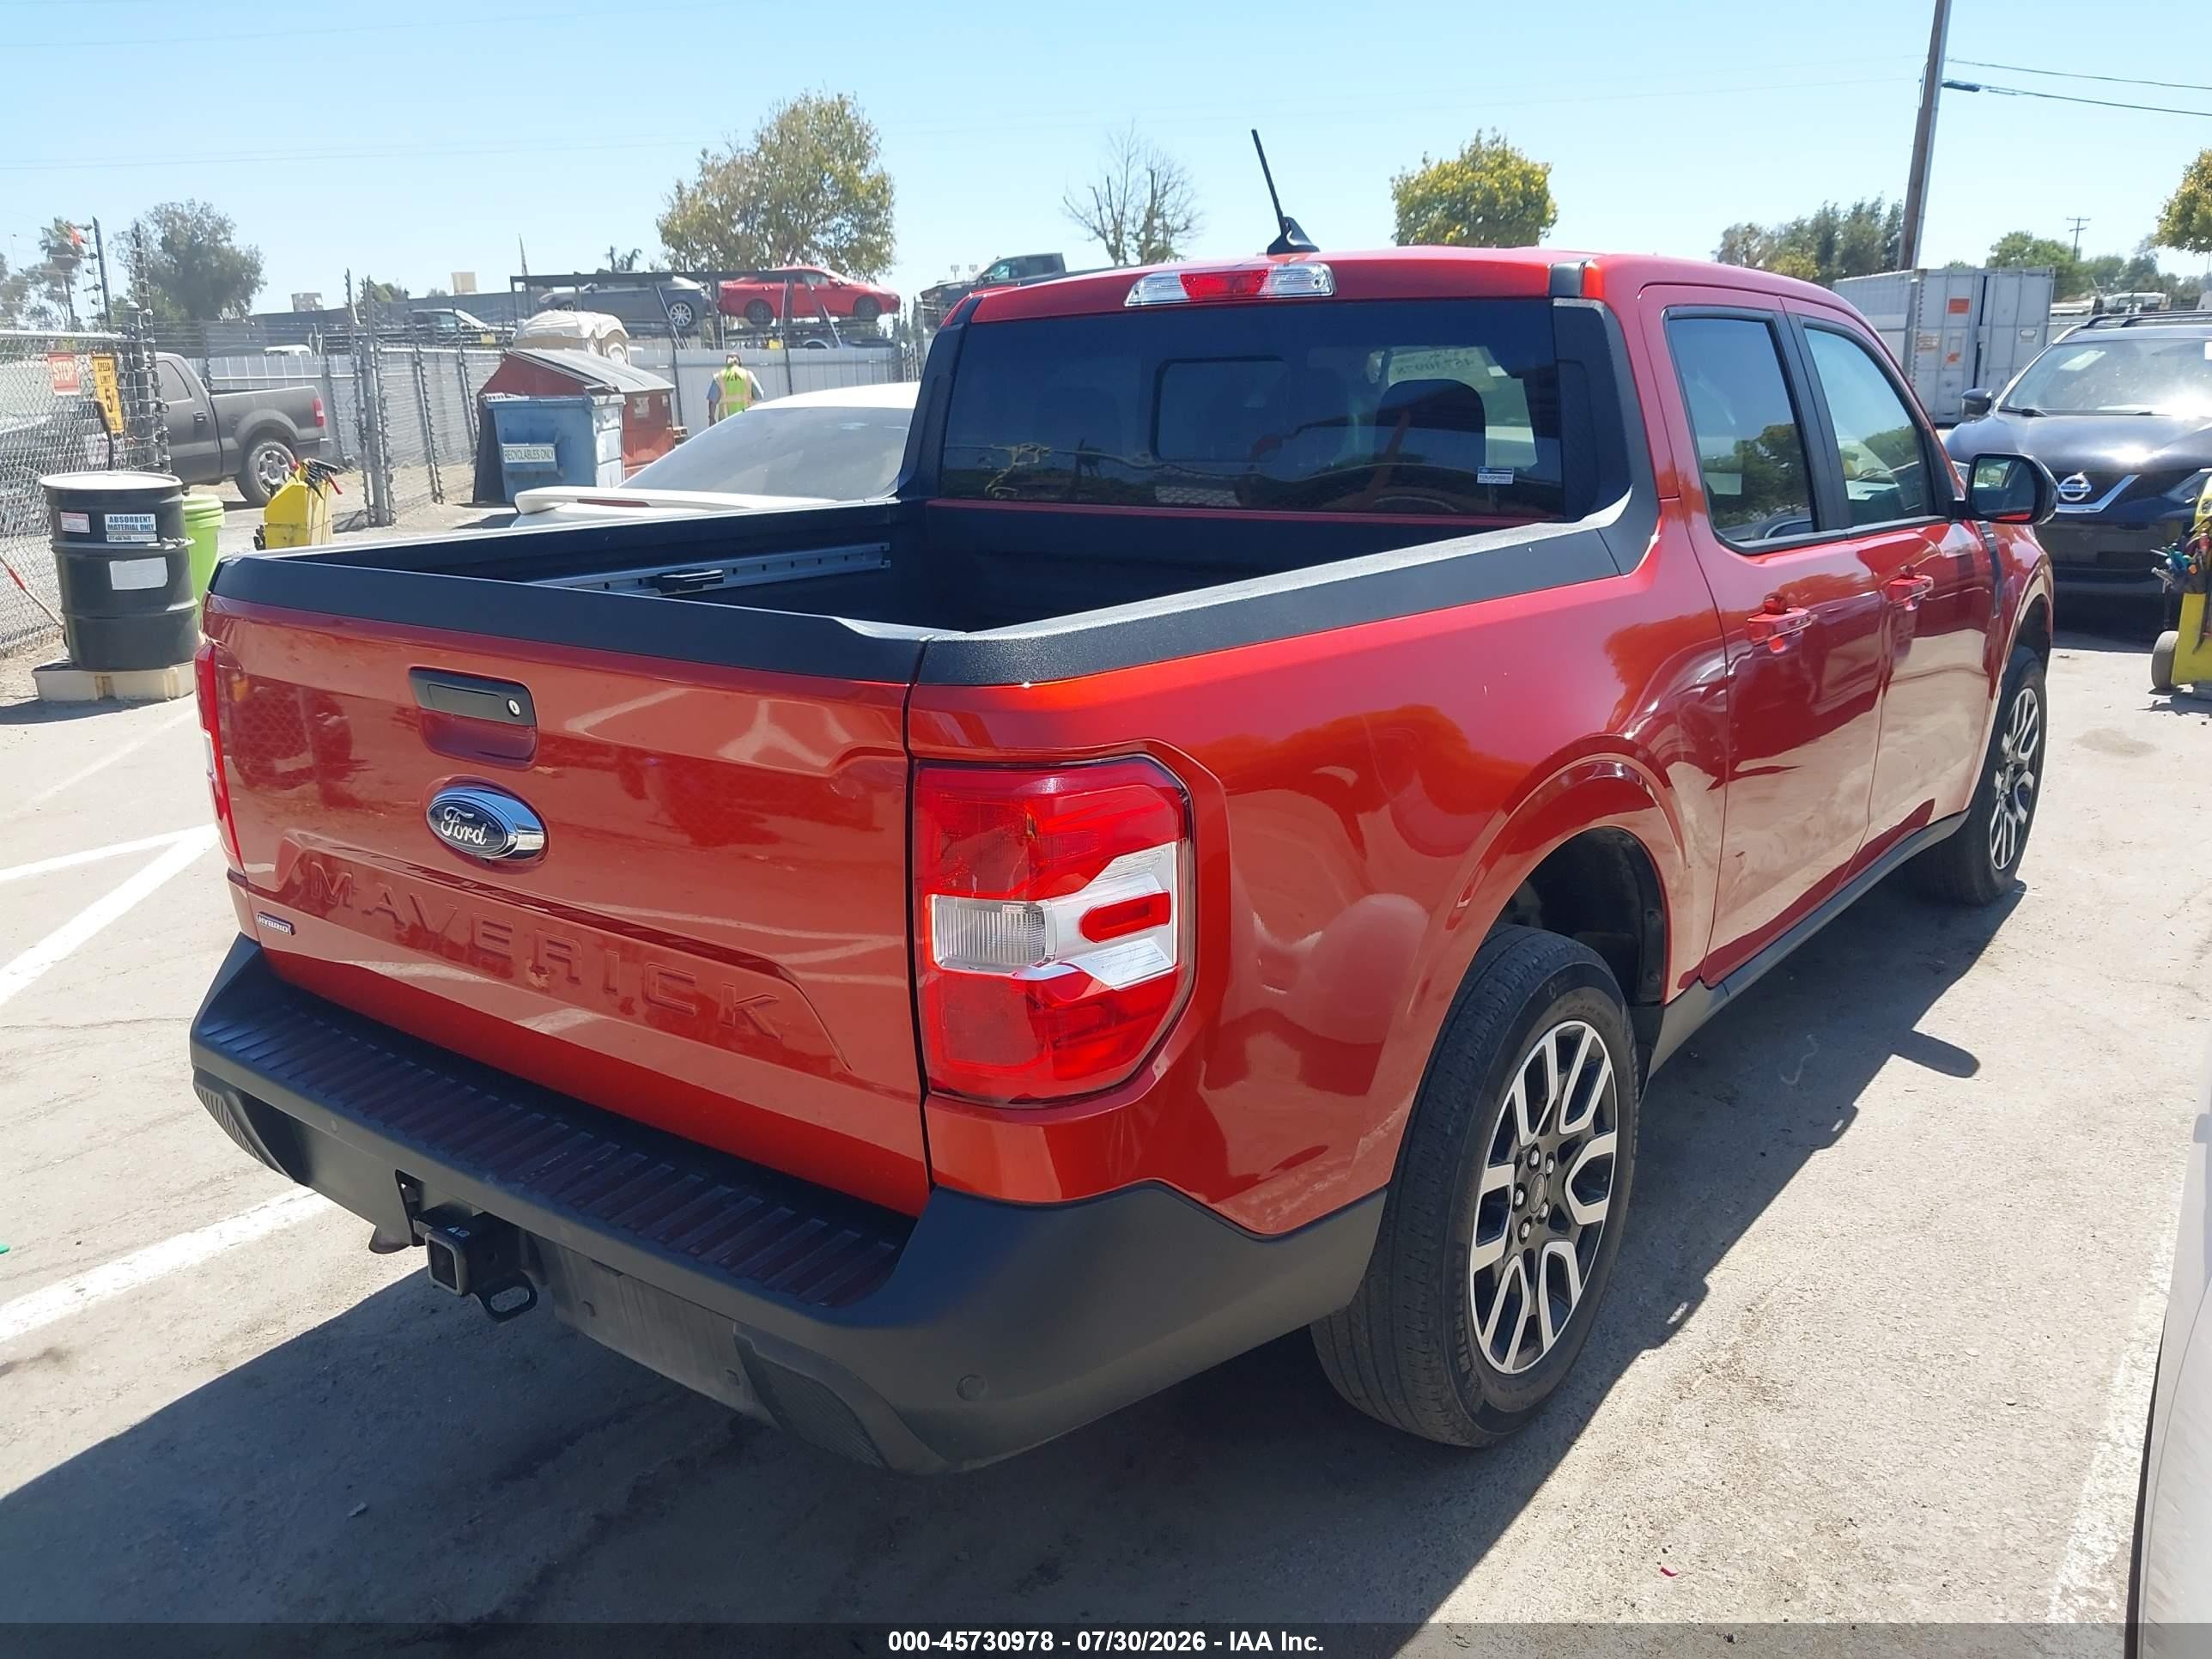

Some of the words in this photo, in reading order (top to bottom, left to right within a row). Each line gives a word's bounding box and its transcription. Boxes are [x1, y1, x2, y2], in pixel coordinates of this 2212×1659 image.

[53, 361, 75, 381] STOP
[98, 362, 111, 371] SPEED
[105, 387, 113, 413] 5
[504, 449, 540, 460] RECYCLABLES
[541, 448, 554, 459] ONLY
[441, 806, 487, 845] Ford
[258, 915, 289, 933] HYBRID
[311, 862, 783, 1040] MAVERICK
